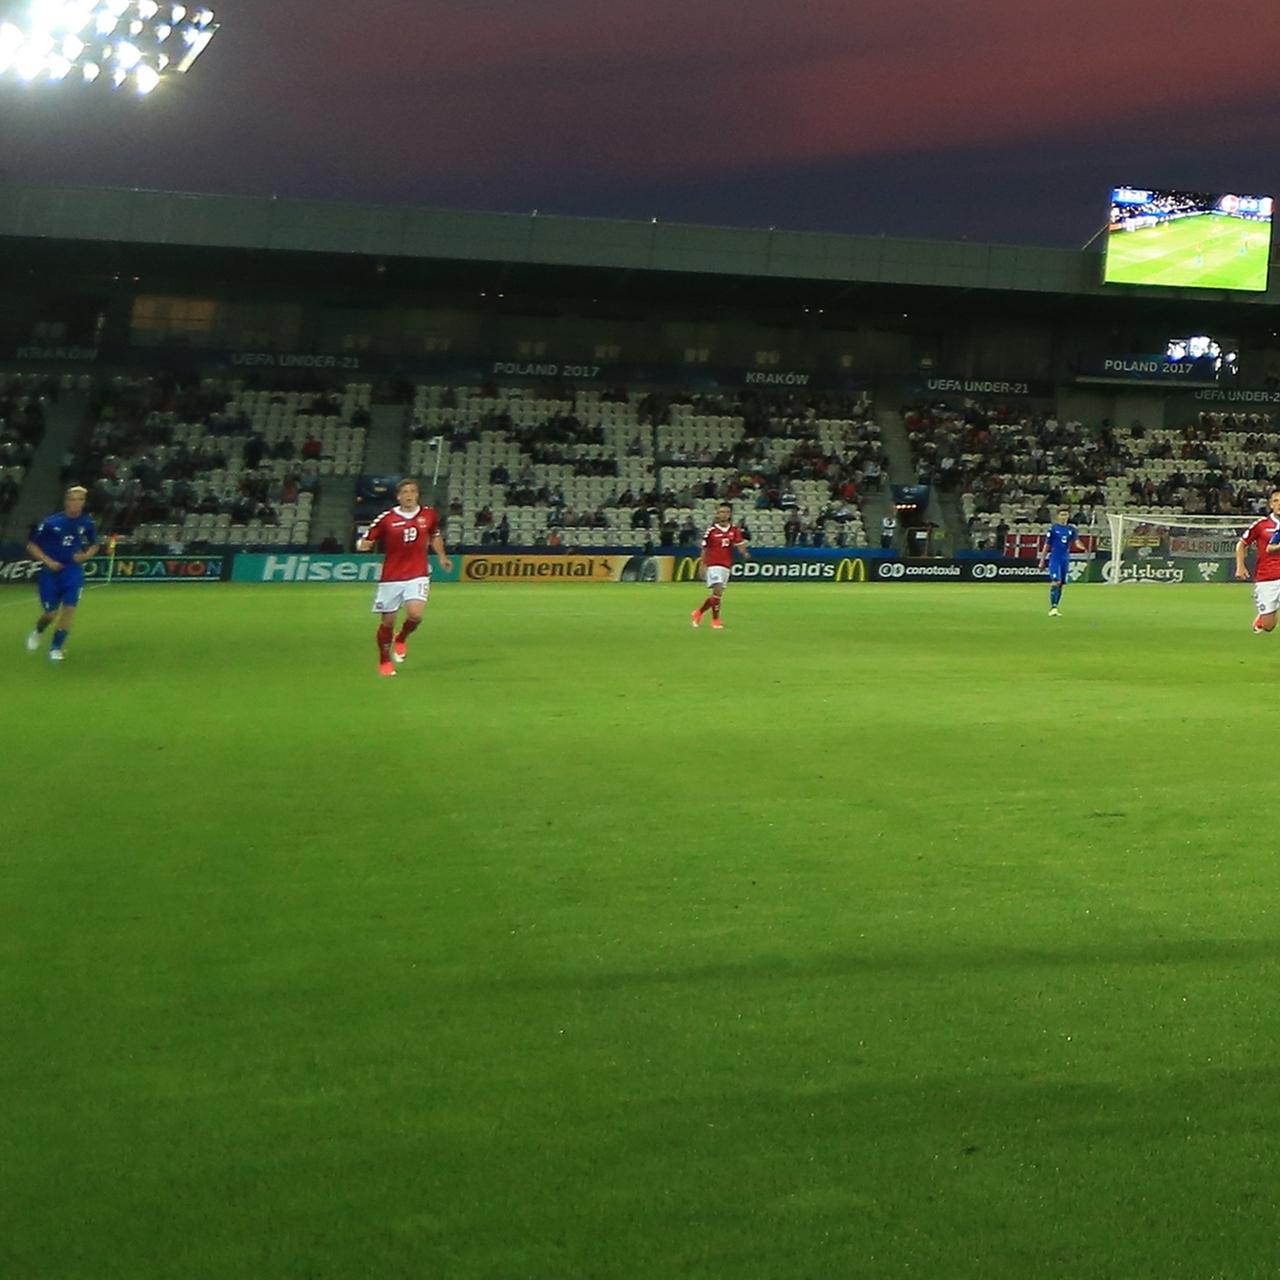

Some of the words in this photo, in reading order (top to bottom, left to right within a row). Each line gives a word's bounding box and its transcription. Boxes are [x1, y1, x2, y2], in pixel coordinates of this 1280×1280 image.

[231, 351, 275, 367] UEFA
[1104, 359, 1158, 373] POLAND
[1162, 362, 1193, 375] 2017
[493, 361, 558, 377] POLAND
[562, 364, 601, 378] 2017
[745, 370, 810, 386] KRAKÓW
[928, 378, 962, 392] UEFA
[964, 380, 1030, 395] UNDER-21
[1194, 389, 1226, 401] UEFA
[403, 526, 418, 542] 19
[82, 560, 224, 576] OUNDATION
[262, 556, 432, 581] Hisen
[465, 558, 594, 580] Continental
[731, 562, 835, 577] cDonald's
[906, 565, 961, 576] conotoxia
